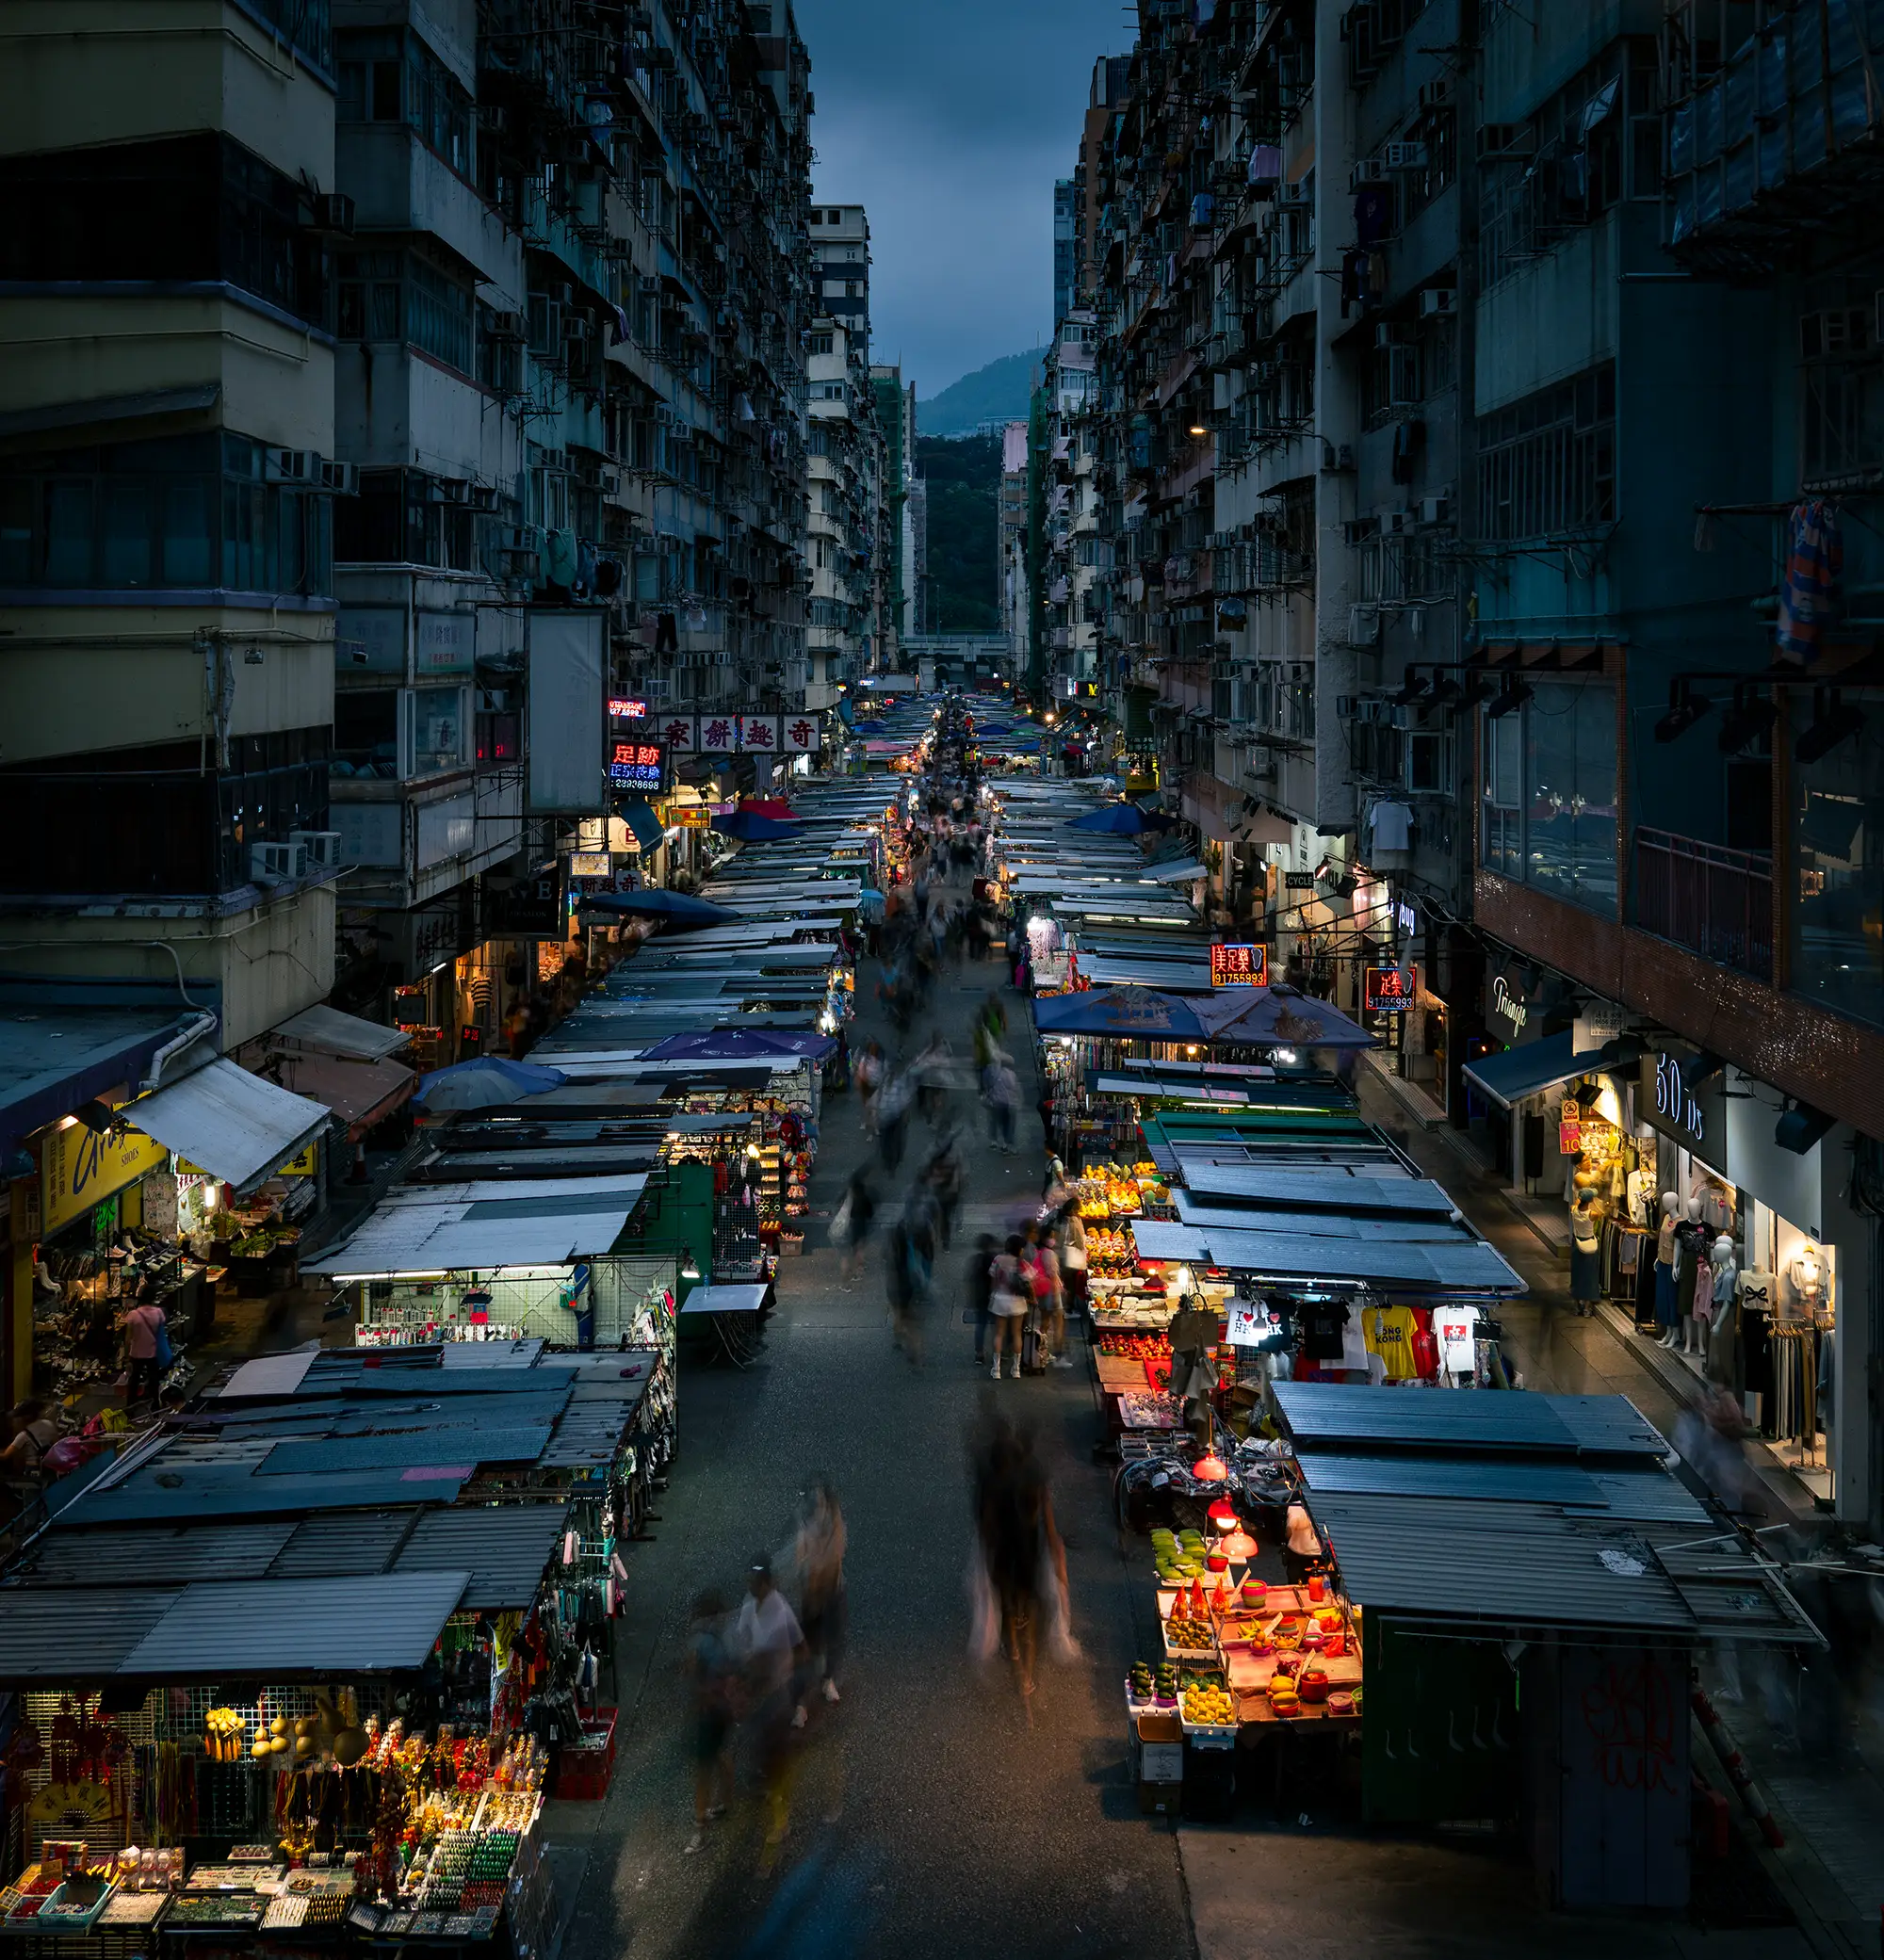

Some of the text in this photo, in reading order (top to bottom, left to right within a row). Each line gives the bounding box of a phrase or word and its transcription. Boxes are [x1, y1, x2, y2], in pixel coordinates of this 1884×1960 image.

[1287, 876, 1313, 886] CYCLE
[1216, 946, 1250, 973] 美足樂
[1214, 973, 1264, 984] 91755993
[1369, 998, 1413, 1009] 91755993
[121, 1146, 139, 1167] SHOES
[1375, 1336, 1403, 1344] KONG
